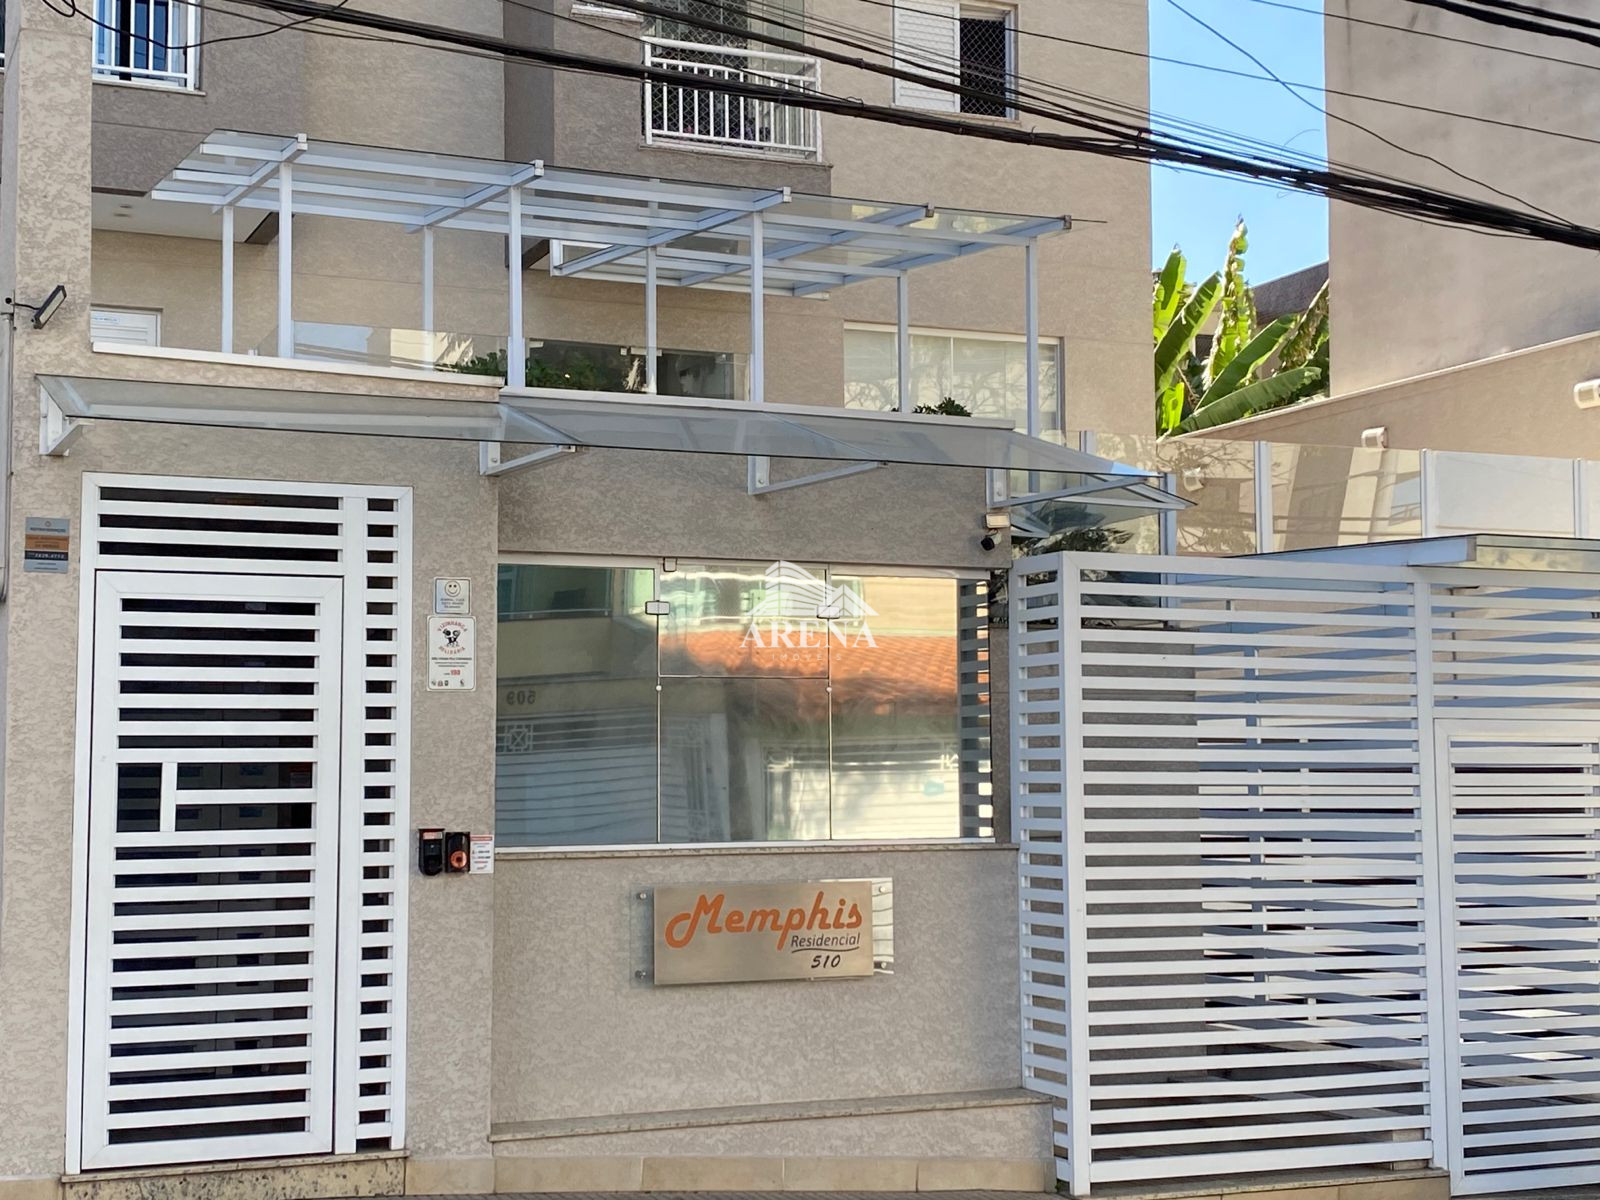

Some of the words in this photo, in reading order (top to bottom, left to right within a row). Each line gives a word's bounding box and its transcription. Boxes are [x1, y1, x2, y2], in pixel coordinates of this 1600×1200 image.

[665, 890, 863, 951] Memphis
[790, 933, 861, 948] Residencial
[811, 954, 841, 969] 510
